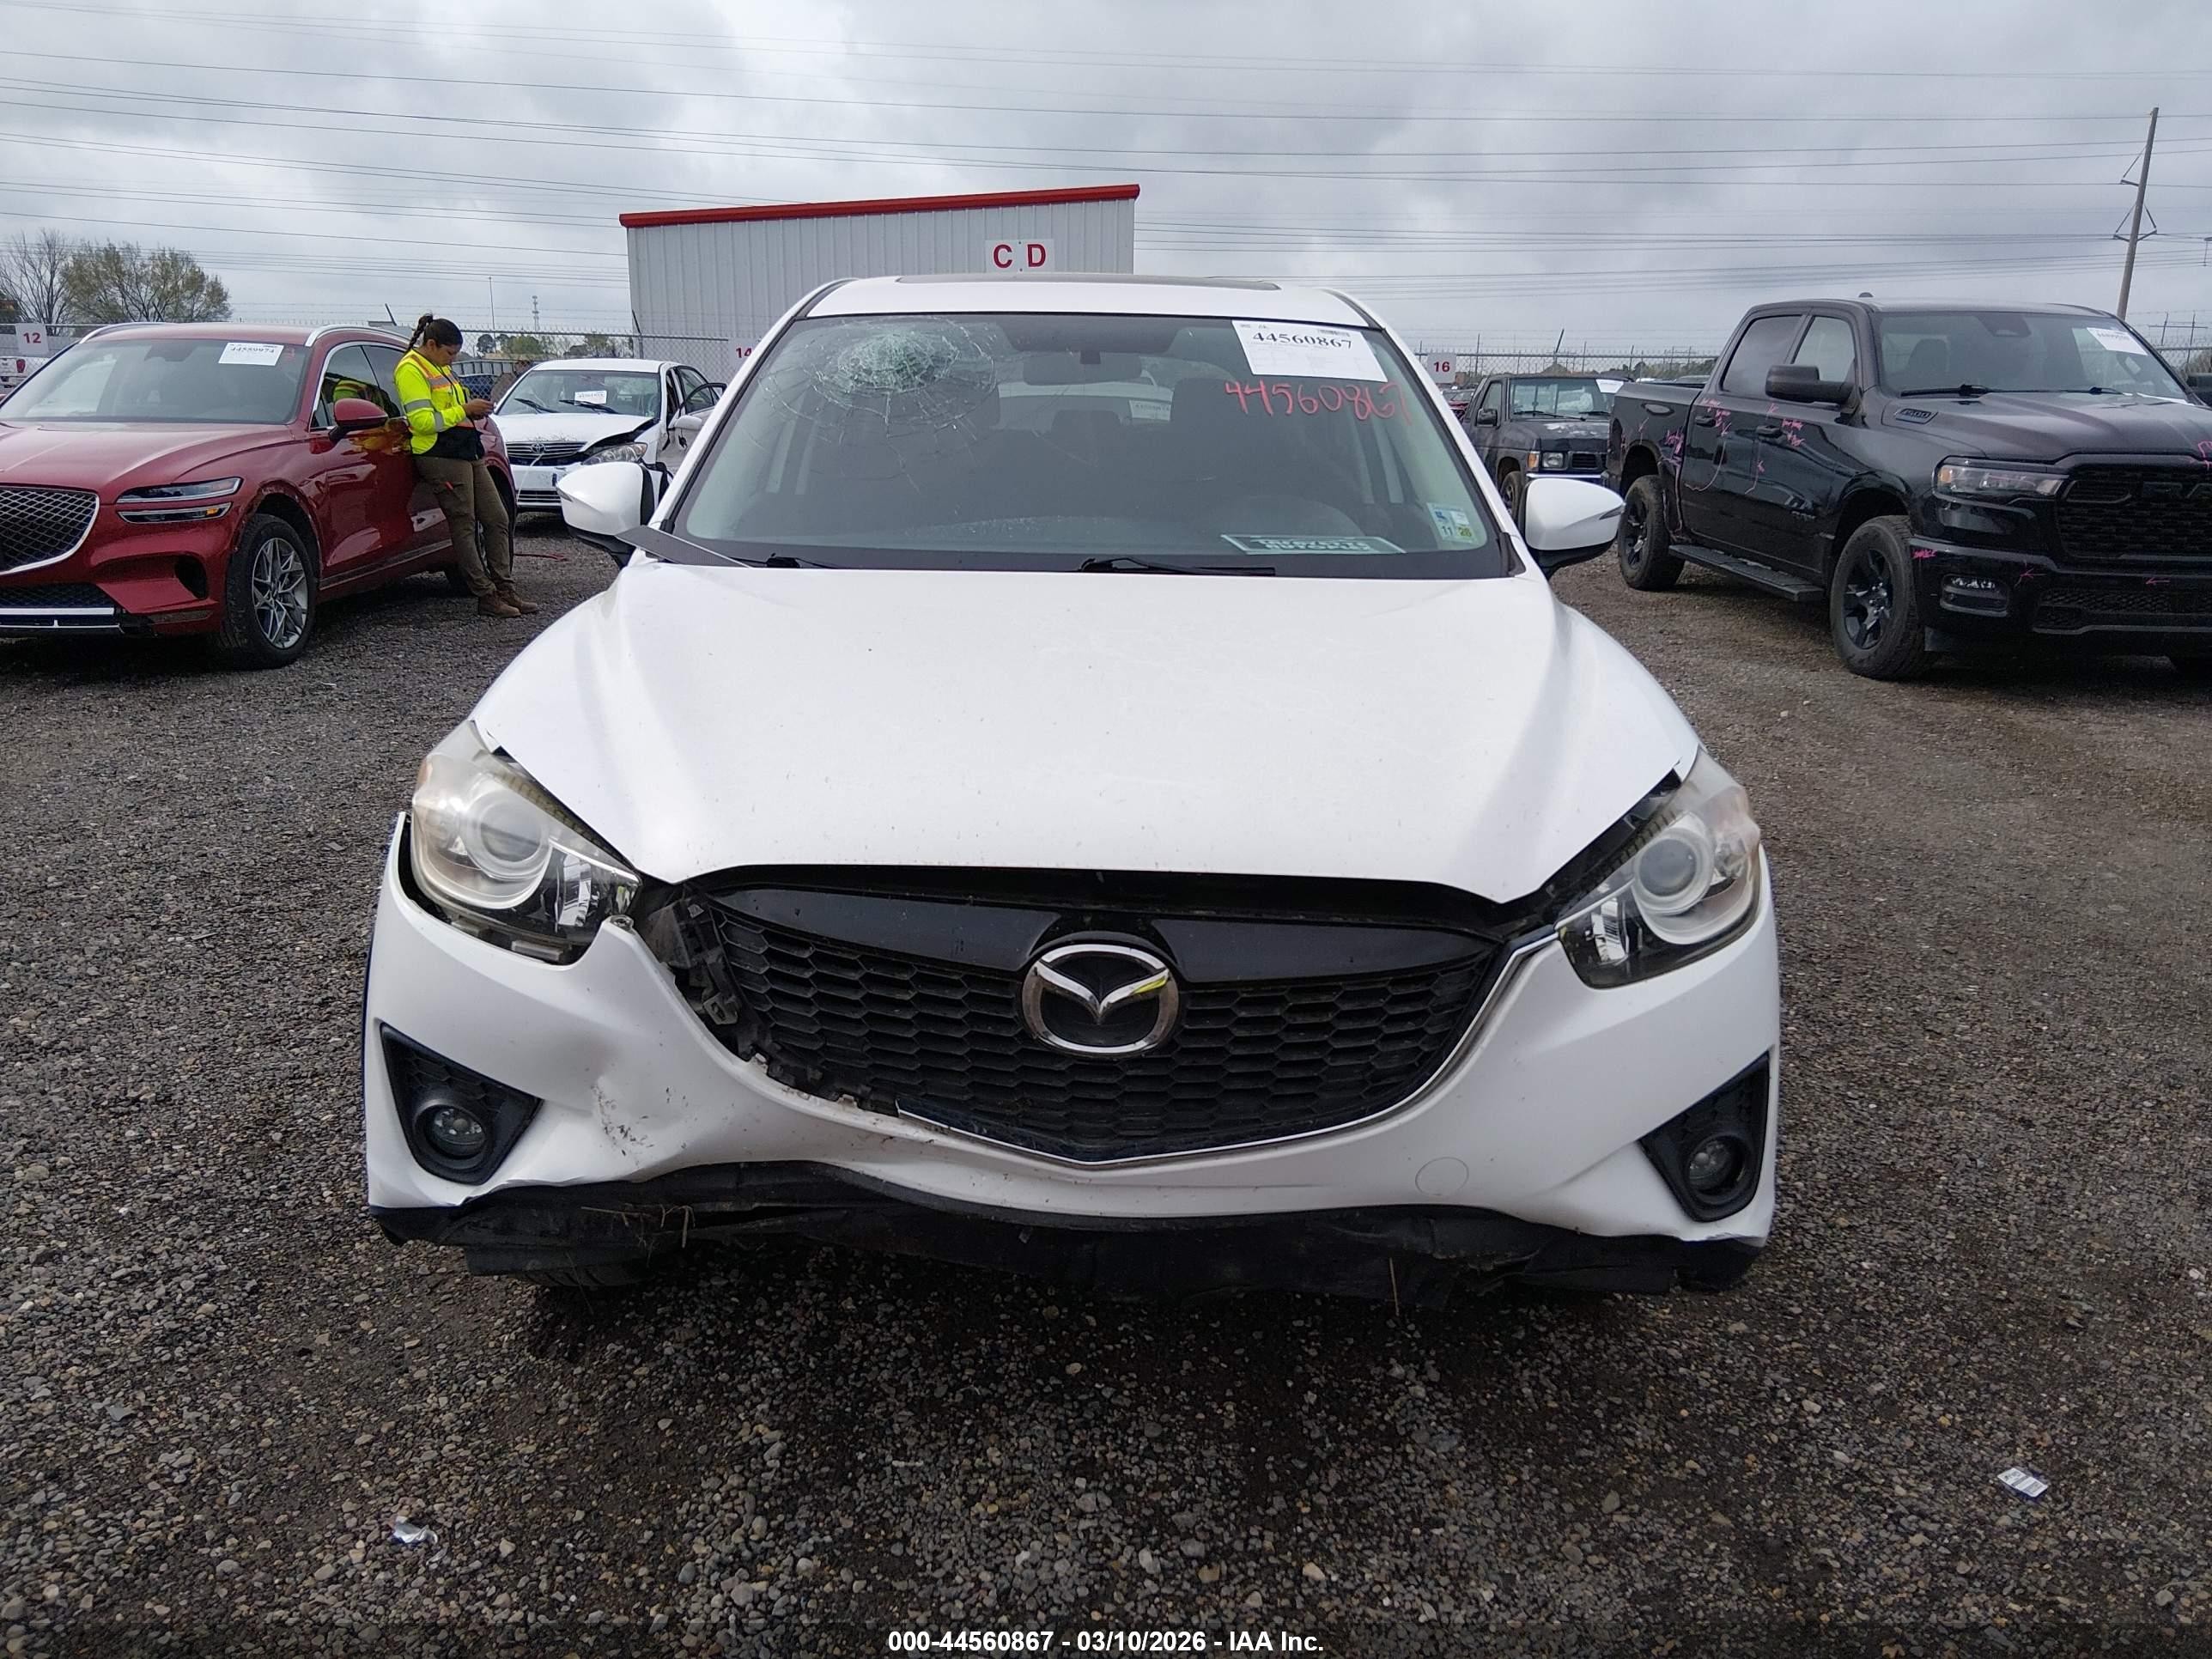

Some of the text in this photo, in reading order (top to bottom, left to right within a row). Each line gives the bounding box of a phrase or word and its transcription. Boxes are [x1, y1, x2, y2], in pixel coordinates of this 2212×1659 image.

[994, 244, 1046, 268] C D
[23, 332, 42, 343] 12
[1253, 331, 1352, 349] 44560867
[1433, 362, 1450, 373] 16
[1224, 380, 1413, 426] 44560867
